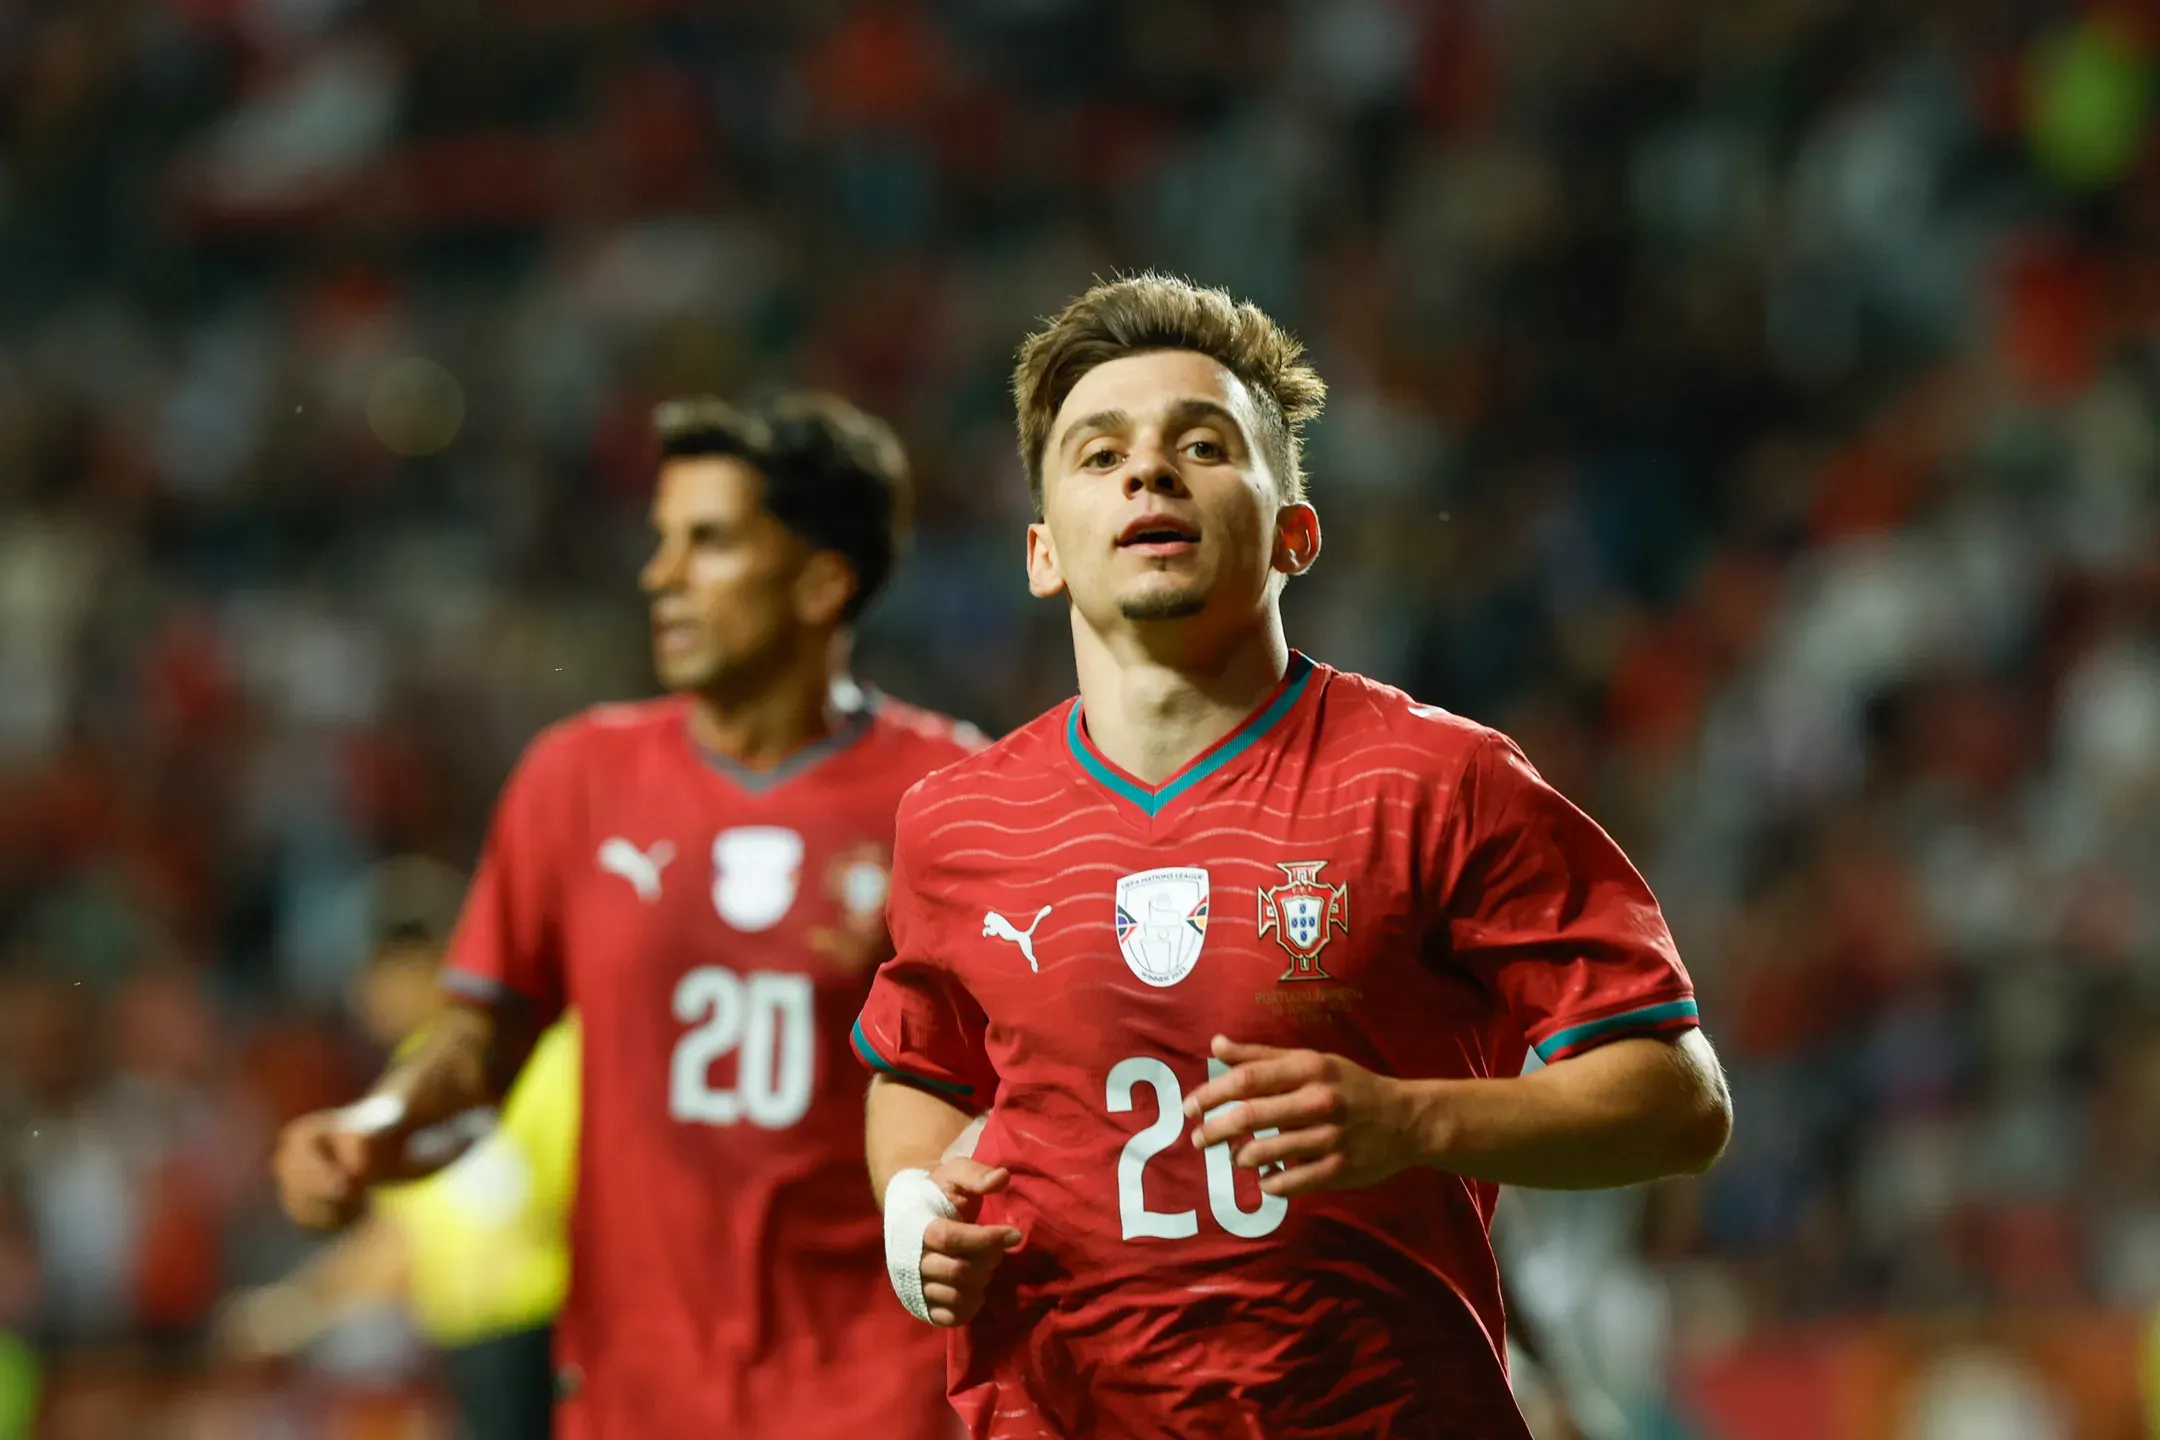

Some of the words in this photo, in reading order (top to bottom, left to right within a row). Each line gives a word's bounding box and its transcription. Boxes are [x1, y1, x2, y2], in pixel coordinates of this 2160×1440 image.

[1141, 873, 1173, 883] NATIONS
[1175, 872, 1204, 881] LEAGUE
[670, 966, 815, 1129] 20
